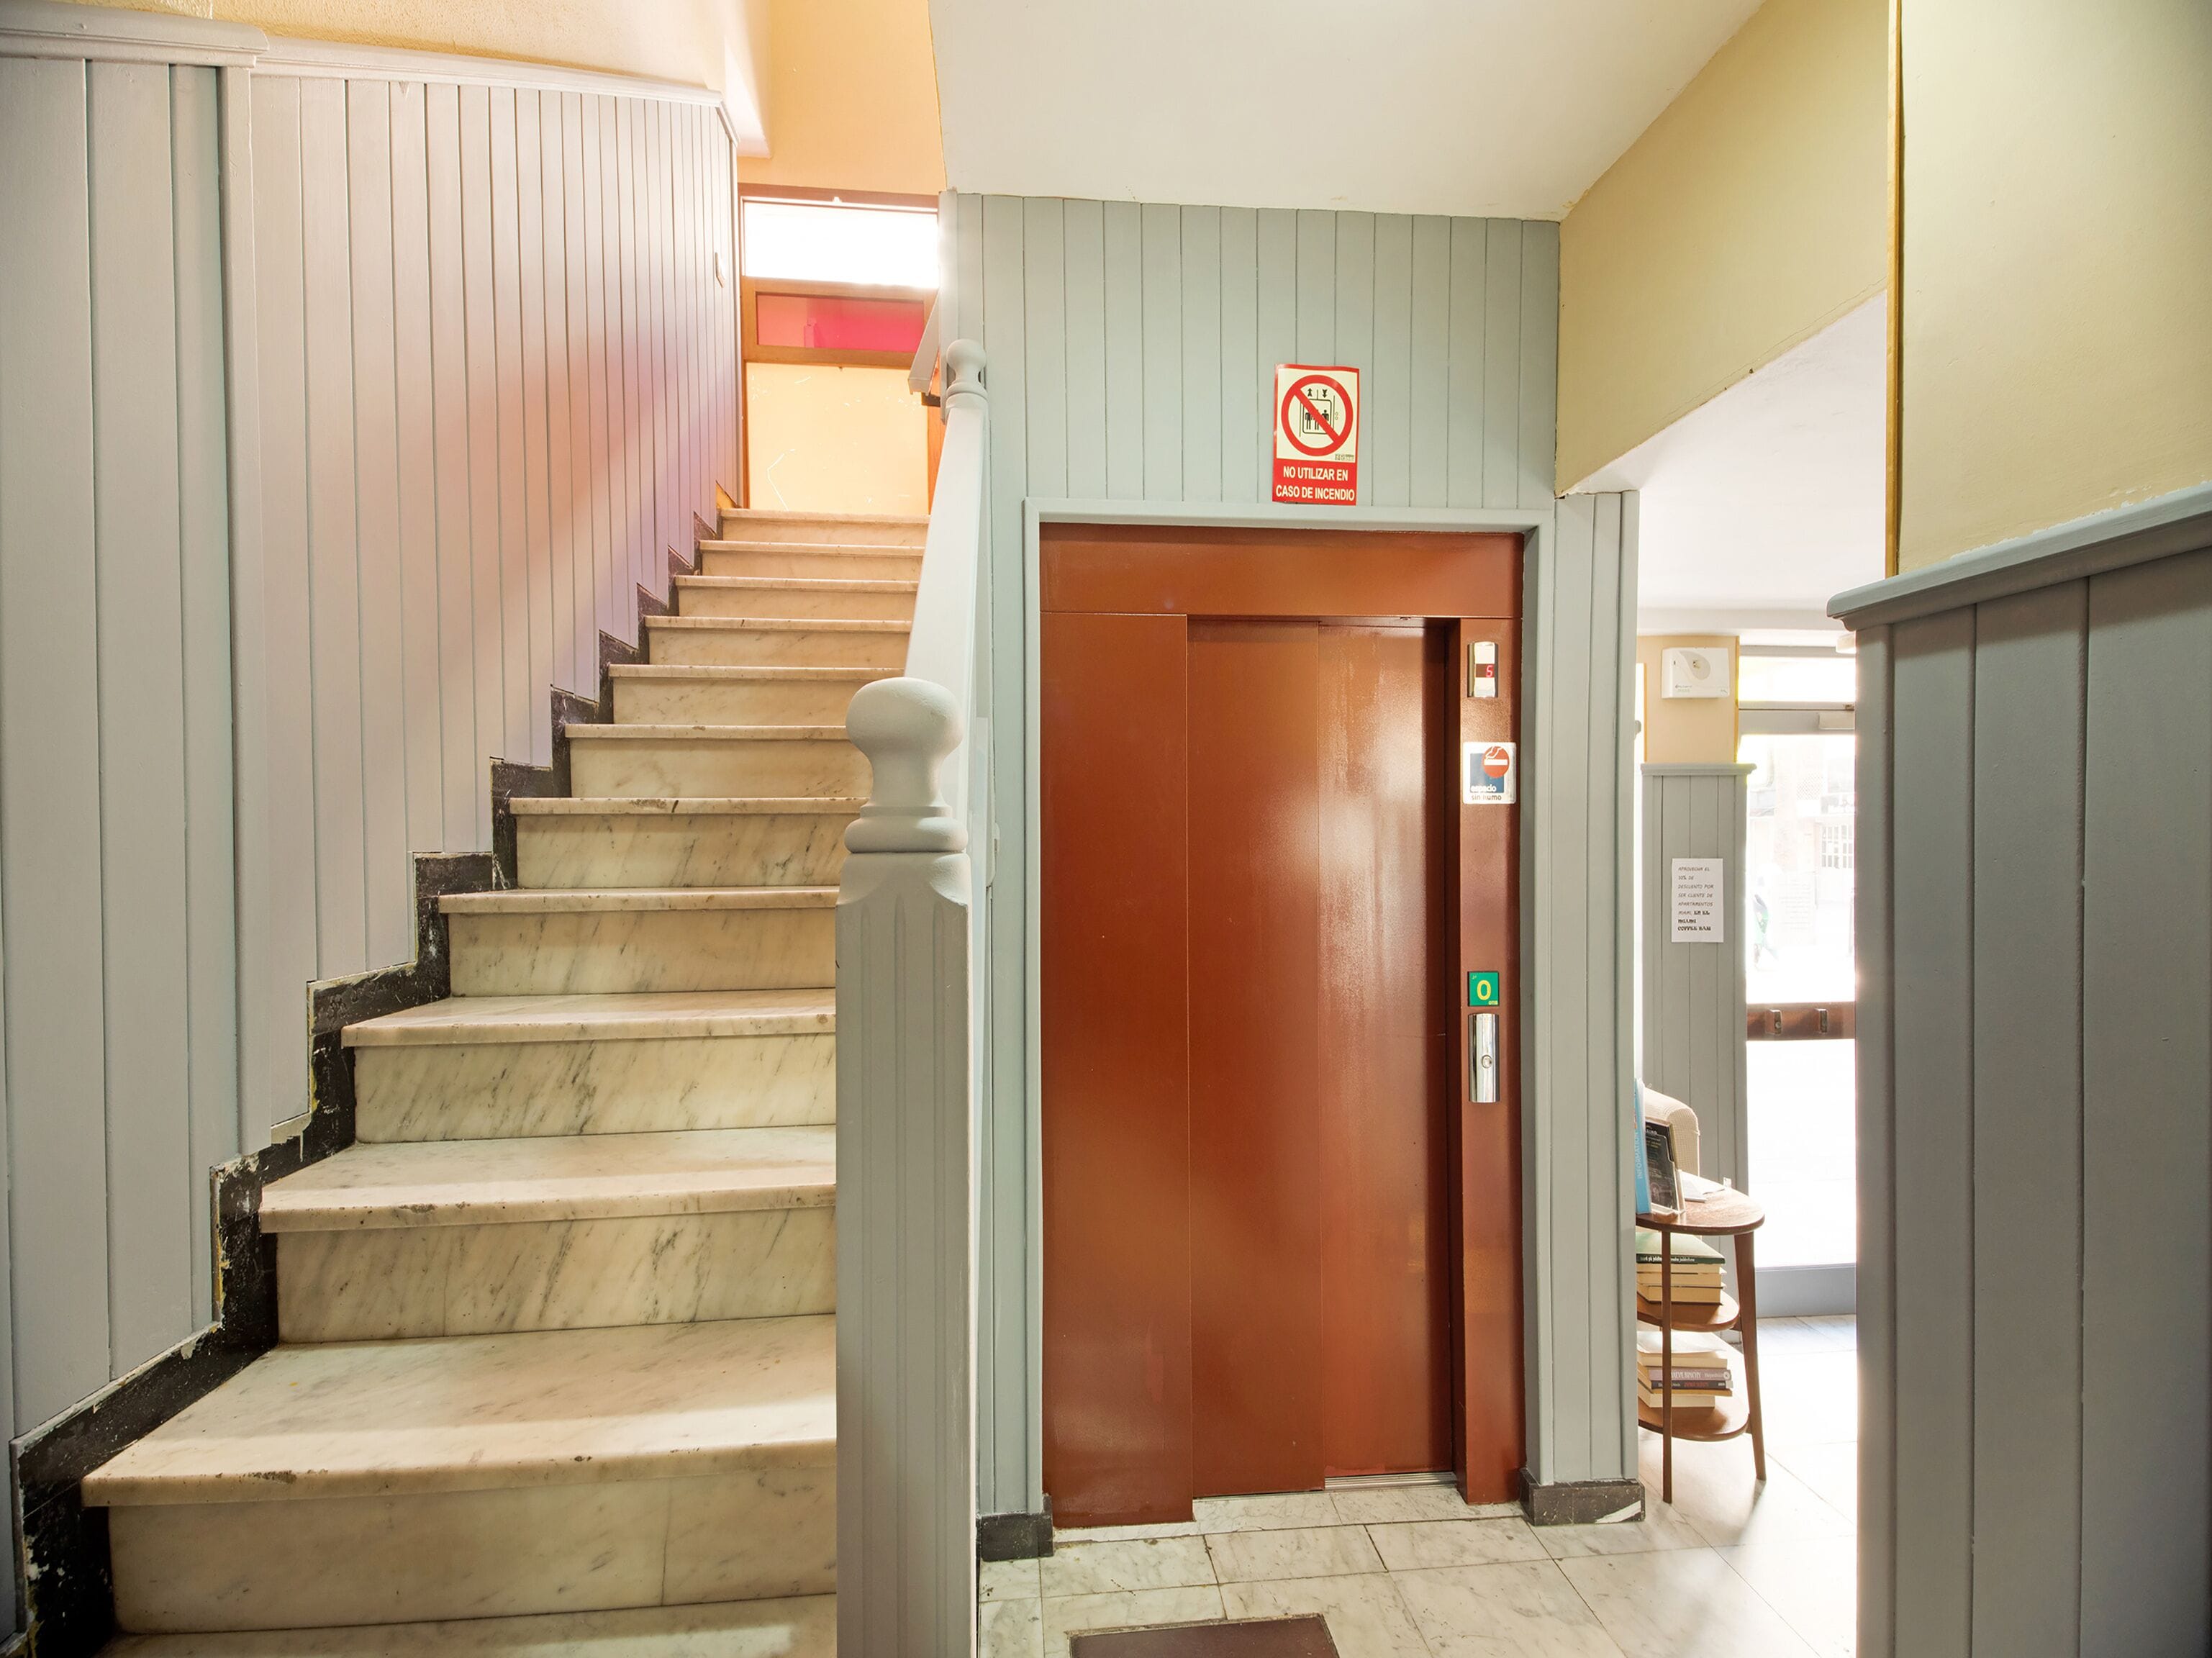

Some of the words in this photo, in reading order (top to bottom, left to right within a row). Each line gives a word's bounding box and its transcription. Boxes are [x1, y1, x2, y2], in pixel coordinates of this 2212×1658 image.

[1283, 466, 1296, 479] NO
[1297, 466, 1335, 481] UTILIZAR
[1336, 468, 1348, 481] EN
[1275, 484, 1300, 498] CASO
[1302, 486, 1313, 499] DE
[1315, 487, 1355, 502] INCENDIO
[1486, 664, 1493, 678] 5
[1477, 979, 1491, 1001] 0
